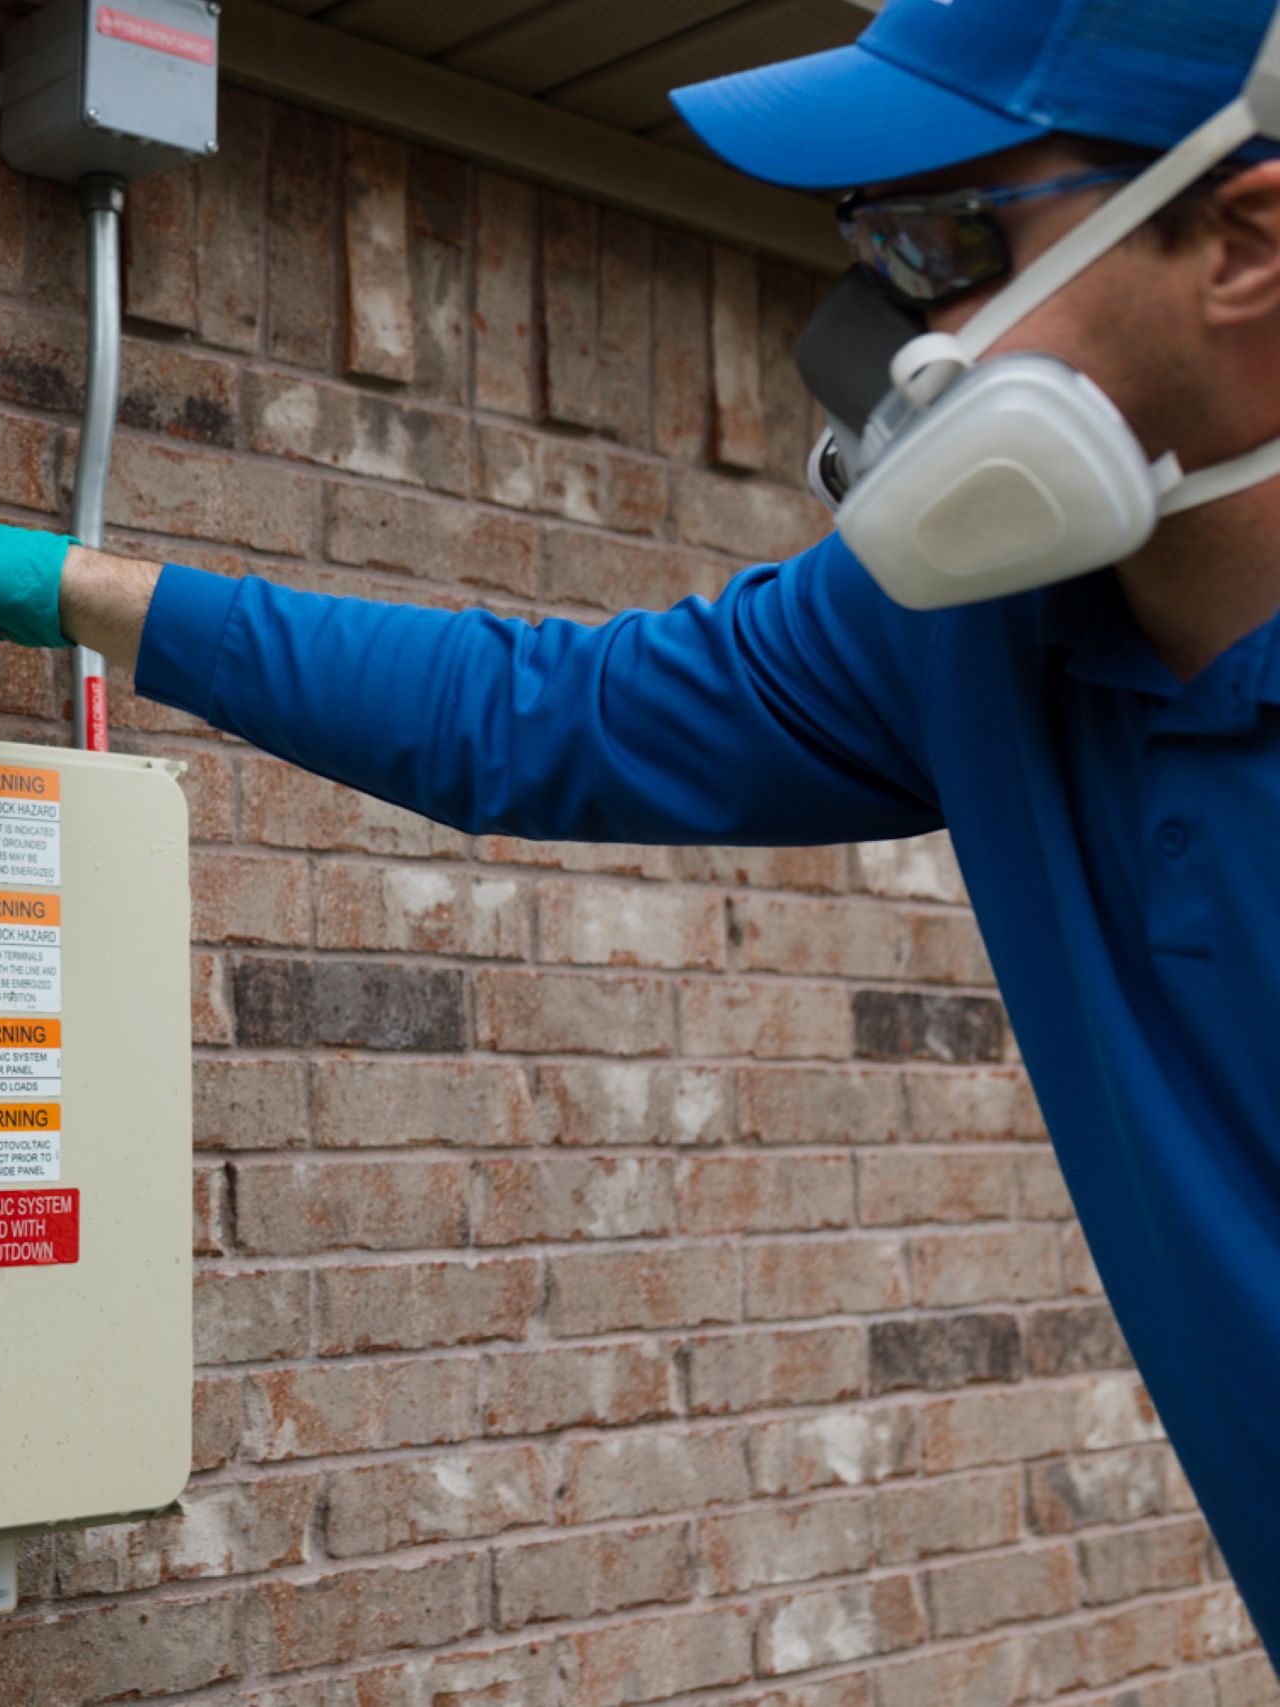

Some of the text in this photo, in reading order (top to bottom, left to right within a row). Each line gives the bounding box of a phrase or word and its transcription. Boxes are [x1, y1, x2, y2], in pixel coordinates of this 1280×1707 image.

[18, 803, 56, 817] HAZARD
[5, 824, 12, 833] IS
[15, 825, 55, 837] INDICATED
[3, 839, 47, 850] GROUNDED
[9, 851, 25, 862] MAY
[28, 853, 38, 863] BE
[11, 866, 55, 877] ENERGIZED
[18, 929, 56, 942] HAZARD
[13, 1052, 47, 1062] SYSTEM
[6, 1065, 33, 1074] PANEL
[10, 1082, 38, 1091] LOADS
[12, 1154, 37, 1162] PRIOR
[40, 1153, 51, 1162] TO
[18, 1166, 44, 1175] PANEL
[18, 1196, 72, 1216] SYSTEM
[11, 1219, 46, 1237] WITH
